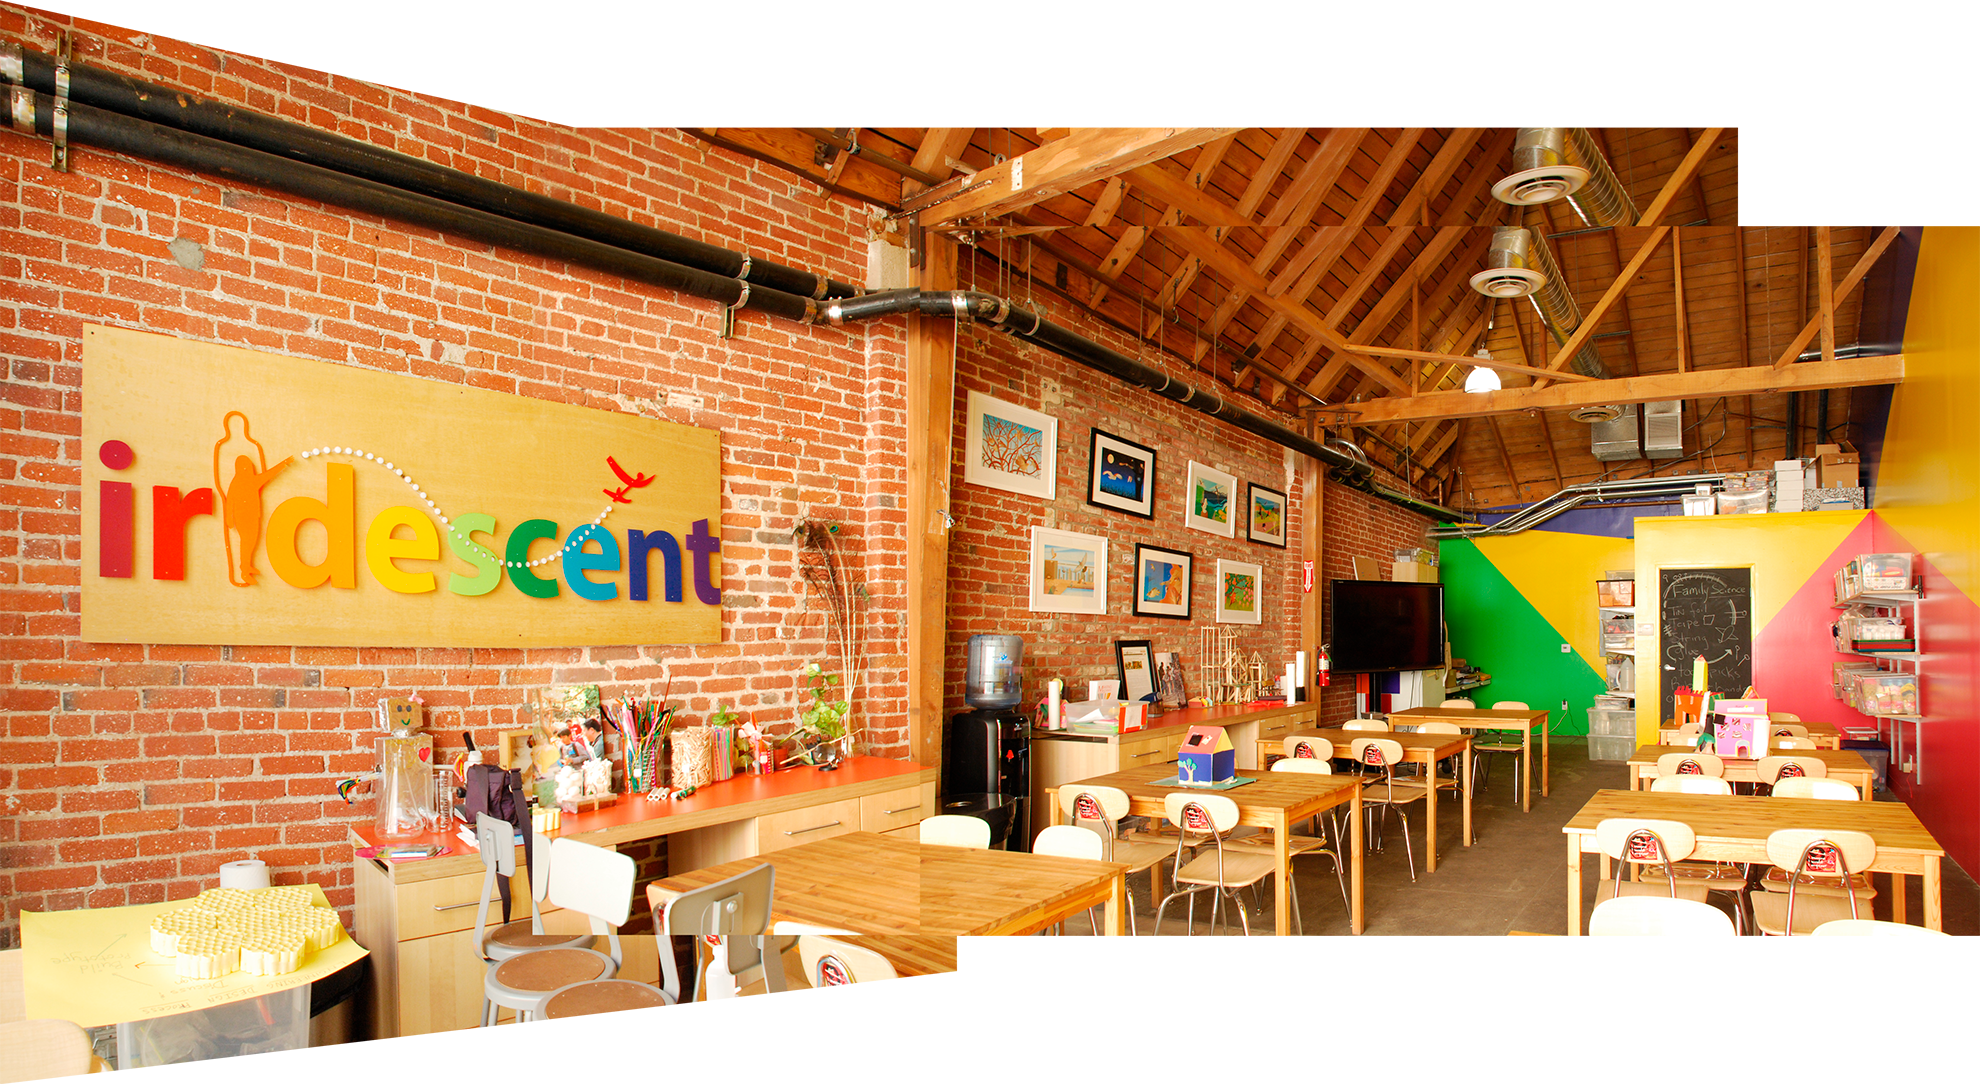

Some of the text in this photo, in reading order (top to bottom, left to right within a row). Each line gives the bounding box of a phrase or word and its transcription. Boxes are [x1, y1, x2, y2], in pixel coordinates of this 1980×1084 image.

[1672, 582, 1746, 604] Family Science
[1690, 602, 1707, 618] foil
[1670, 632, 1709, 651] String
[1674, 642, 1699, 660] glue
[80, 960, 124, 975] Build
[170, 979, 229, 995] Discuss
[207, 986, 258, 1003] DESIGN
